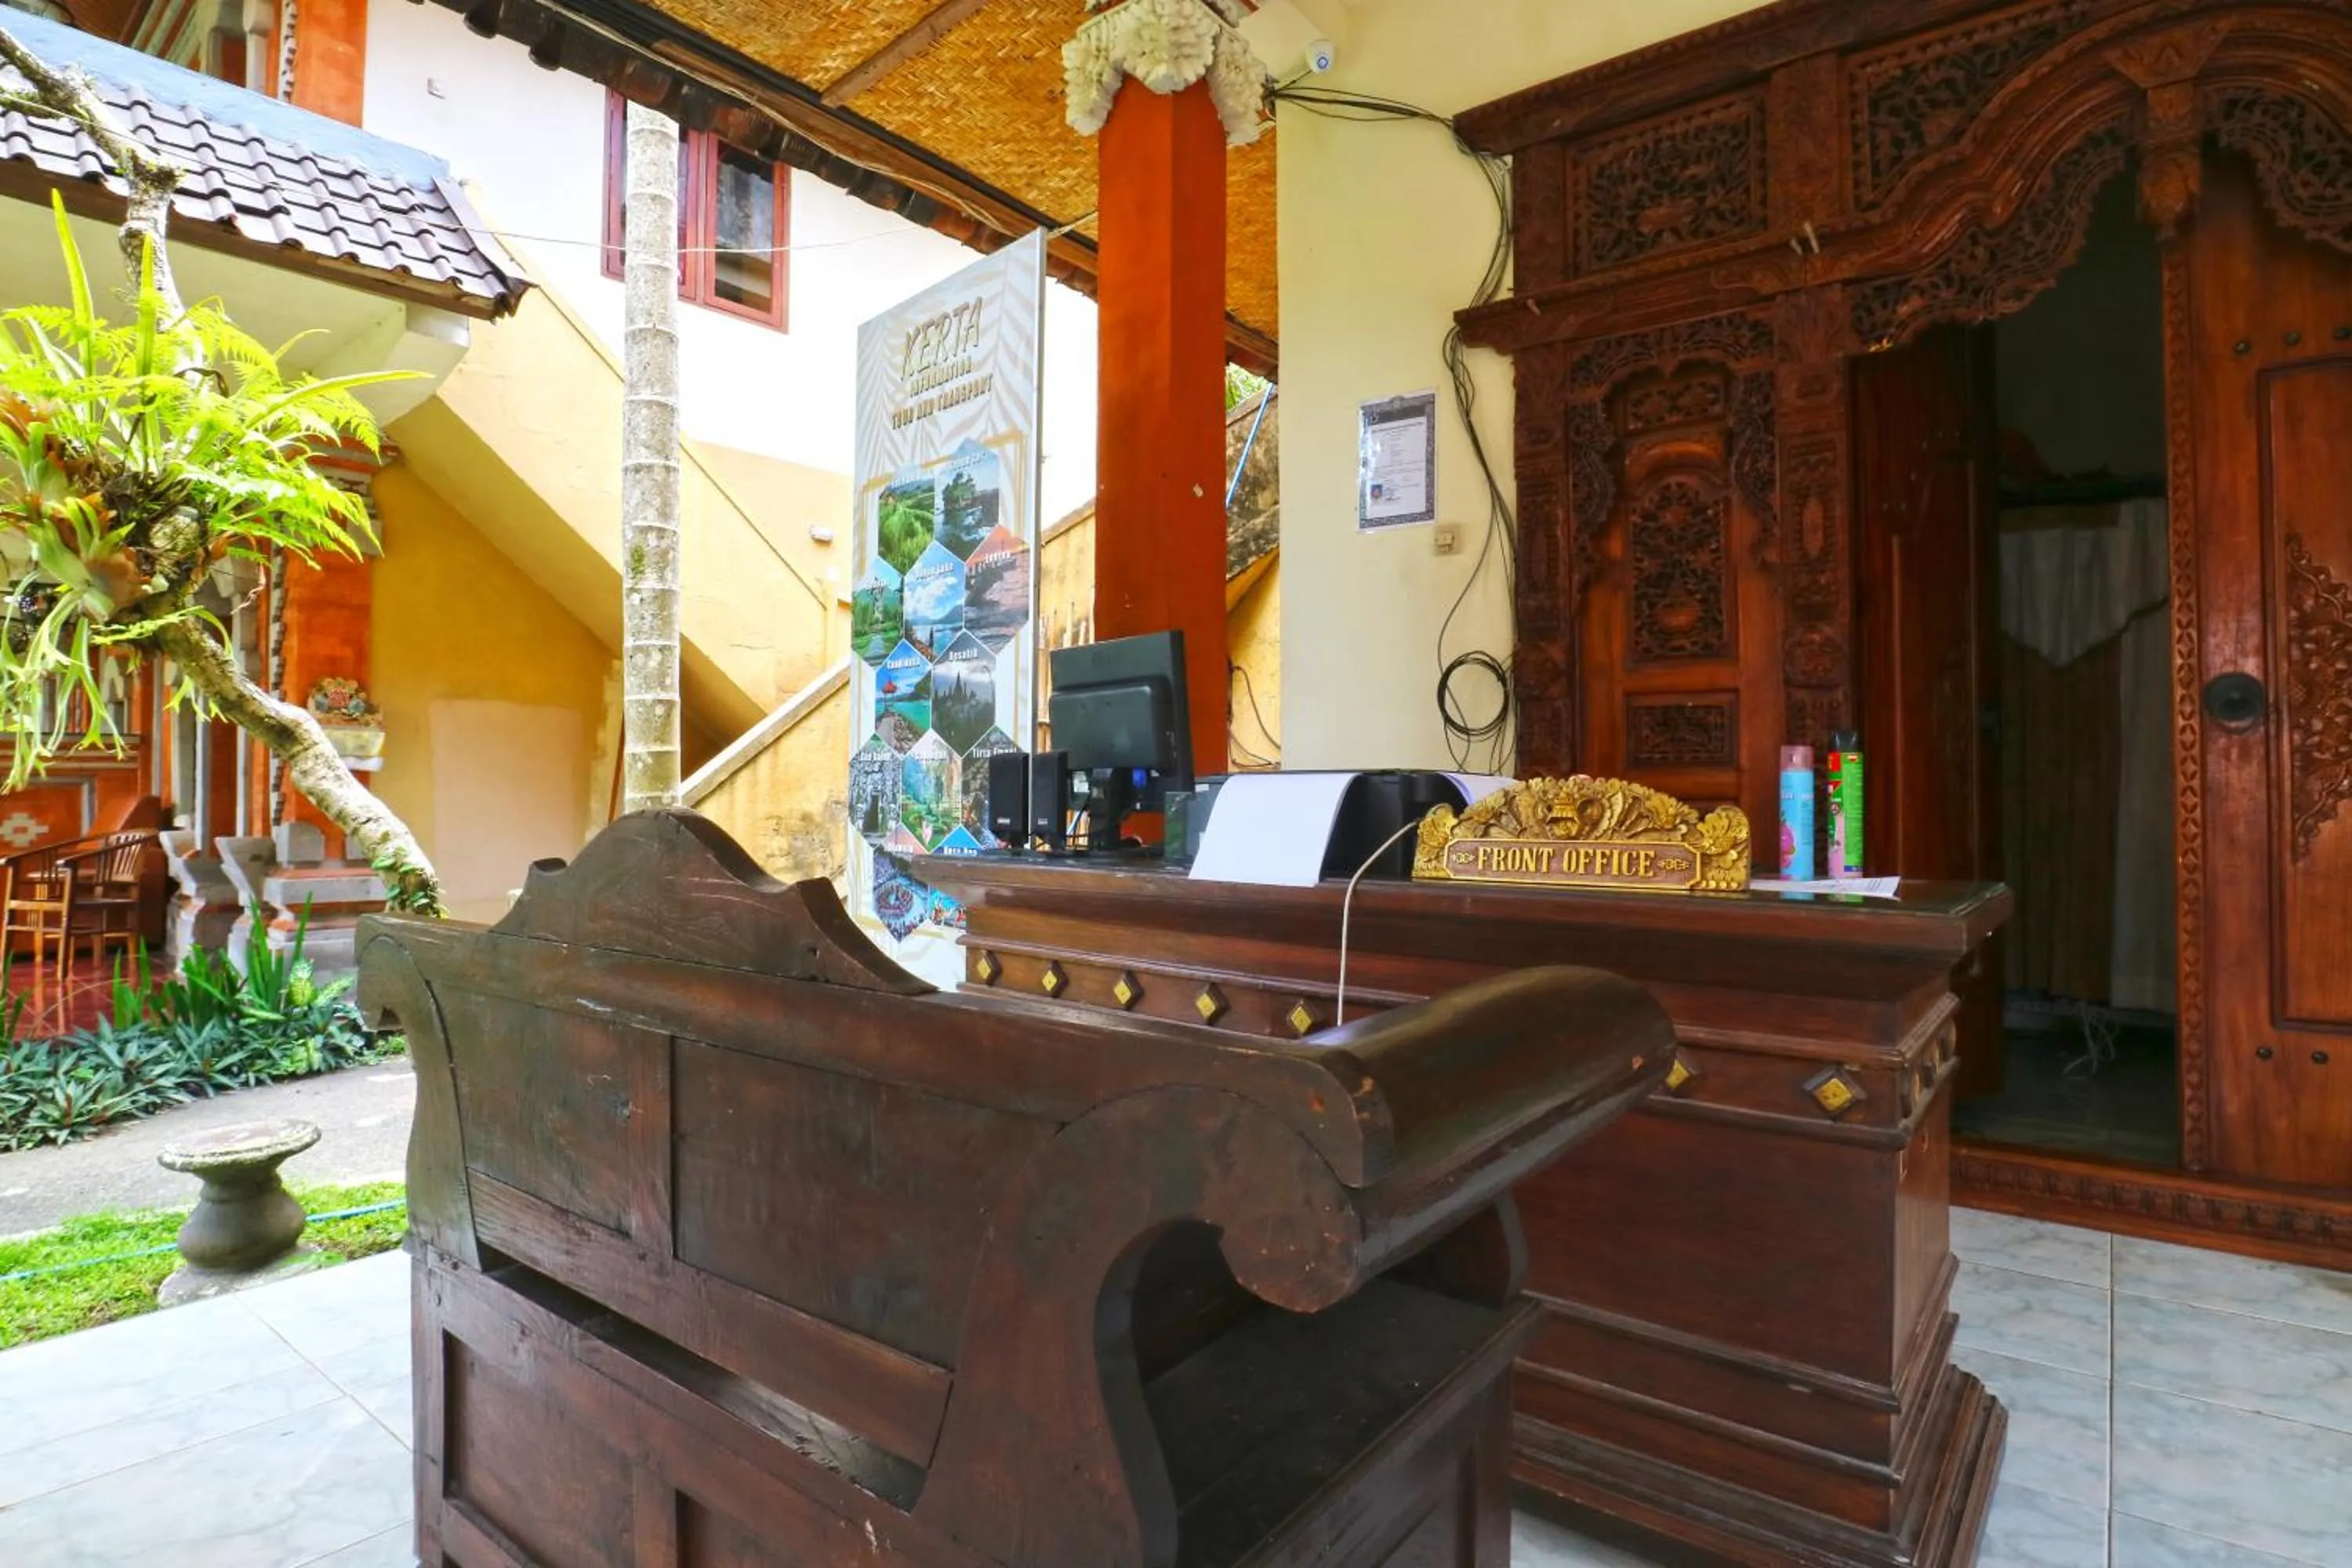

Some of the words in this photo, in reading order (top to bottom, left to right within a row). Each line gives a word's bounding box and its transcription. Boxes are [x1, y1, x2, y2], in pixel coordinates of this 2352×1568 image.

[901, 296, 982, 381] KERTA
[909, 355, 971, 397] INFORMATION
[891, 405, 914, 430] TOUR
[916, 397, 935, 420] AND
[937, 373, 993, 411] TRANSPORT
[1477, 846, 1554, 874] FRONT
[1562, 848, 1657, 878] OFFICE
